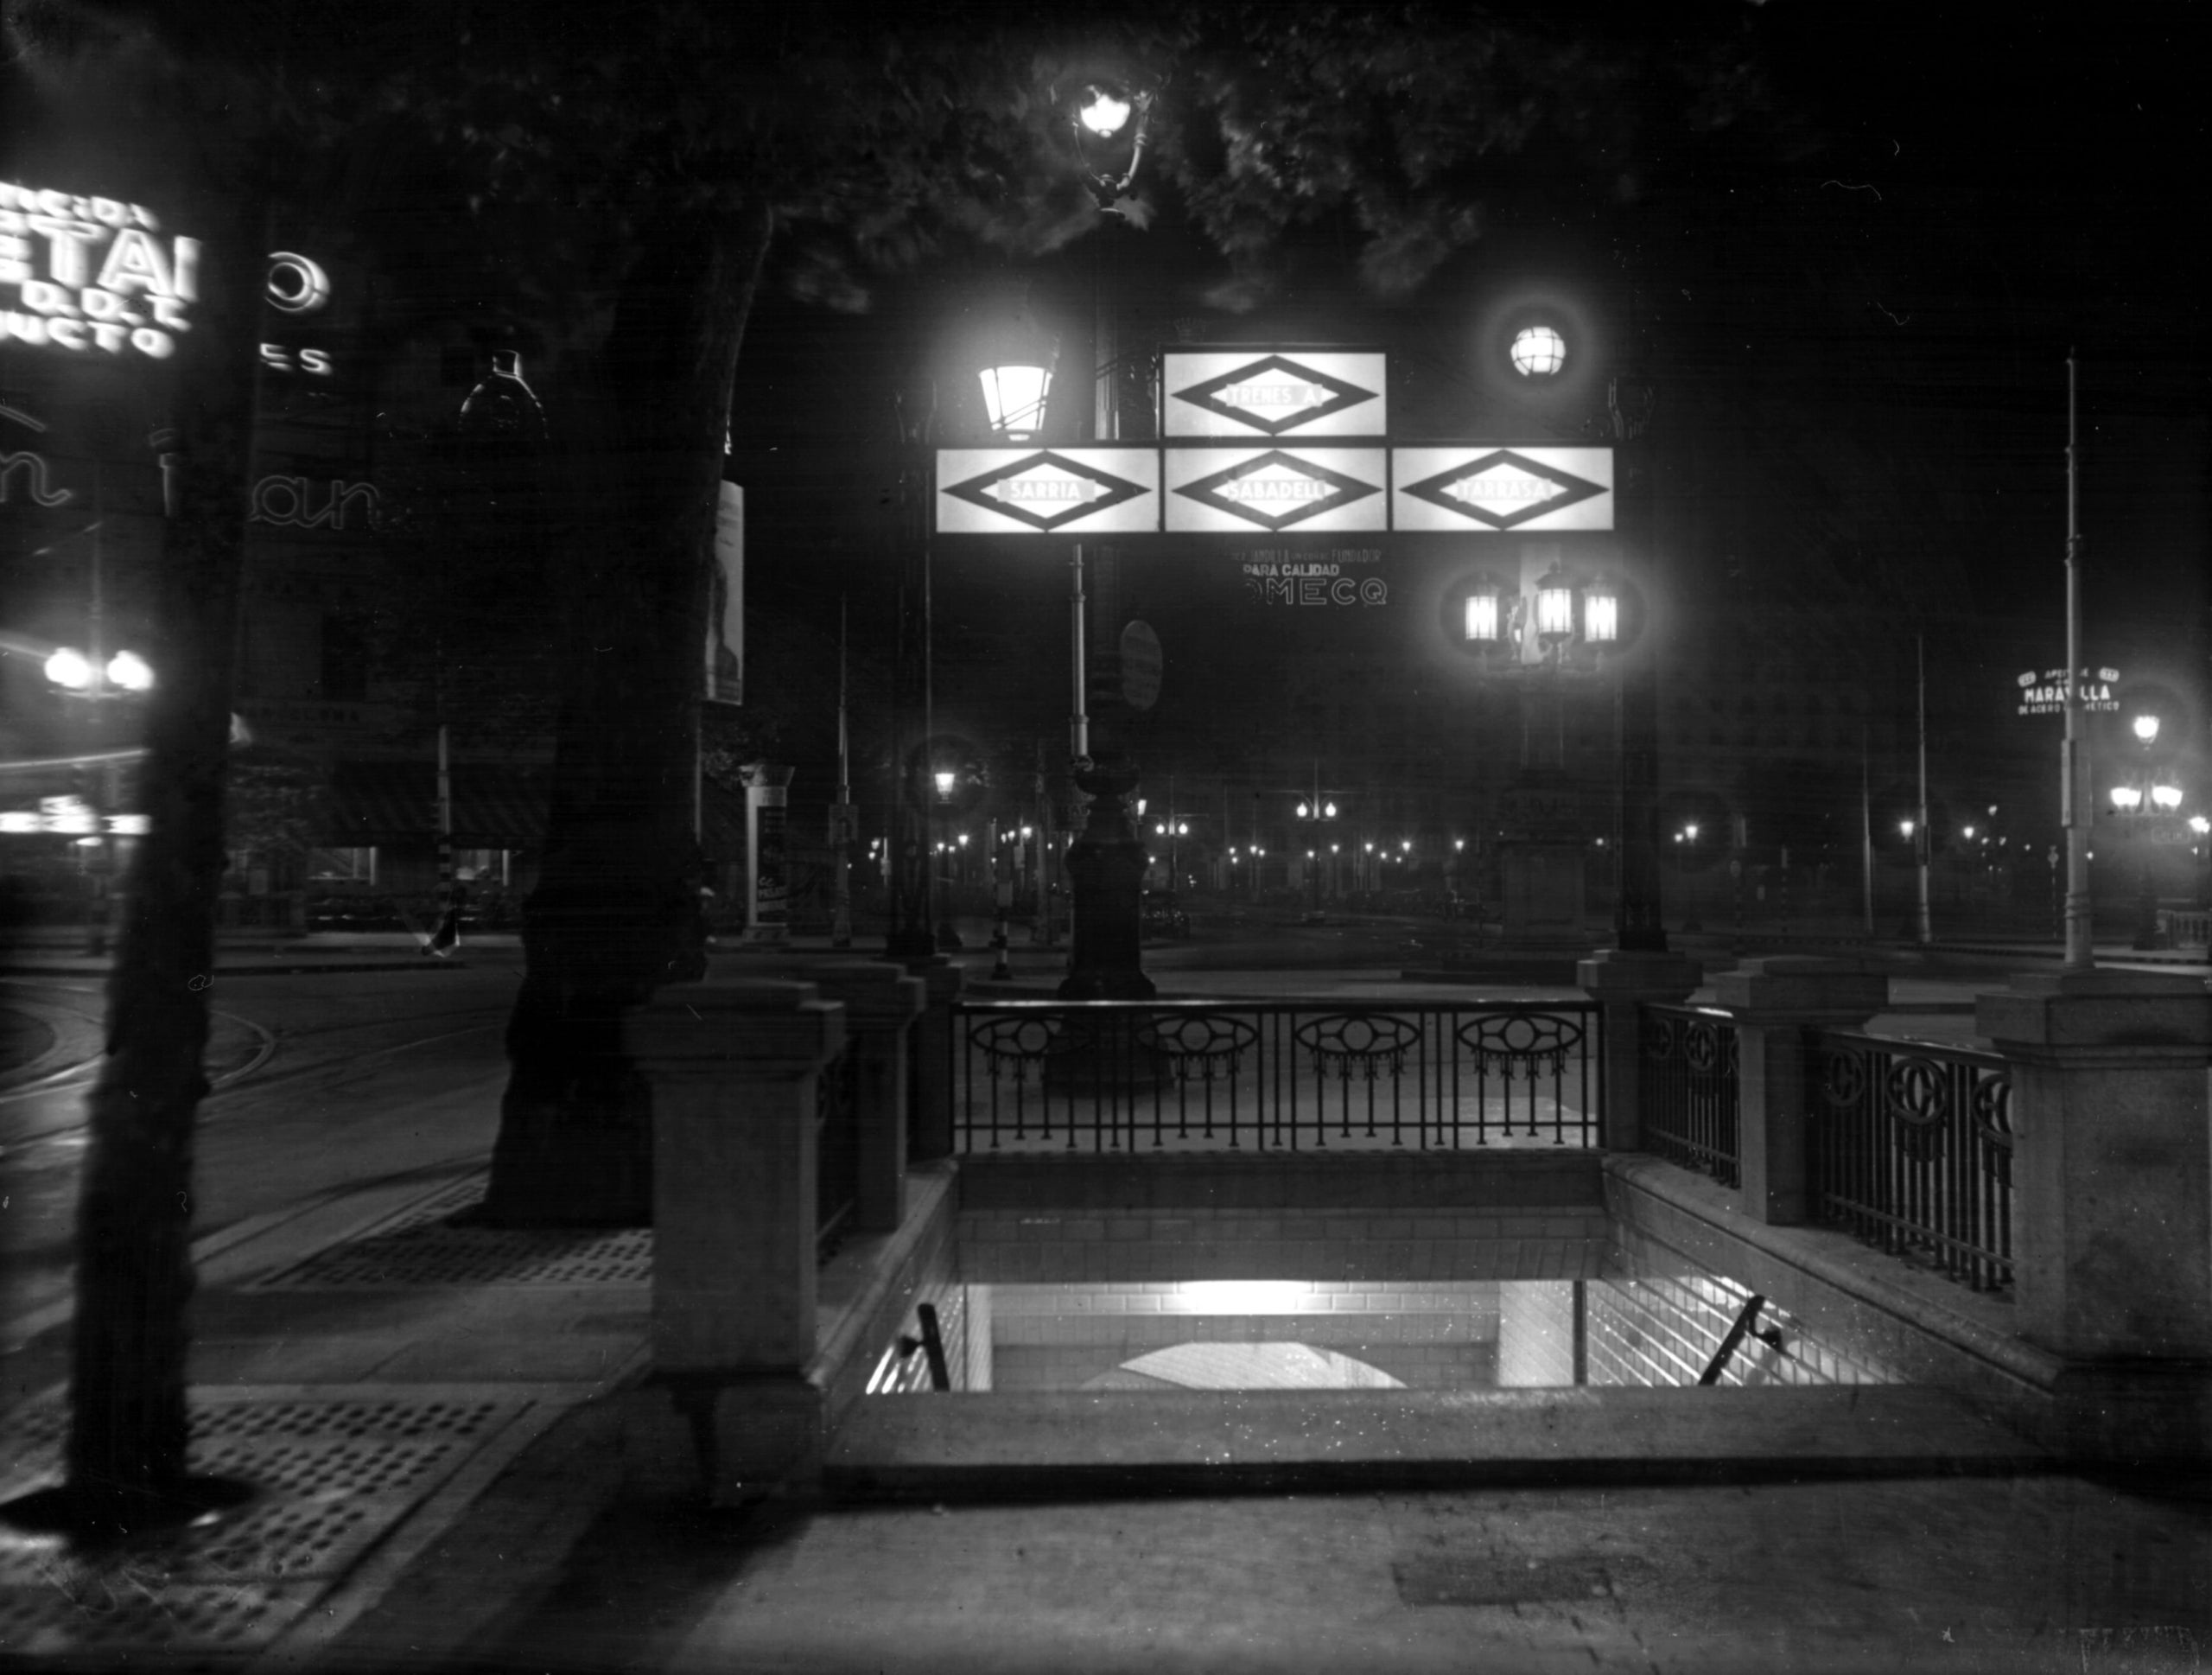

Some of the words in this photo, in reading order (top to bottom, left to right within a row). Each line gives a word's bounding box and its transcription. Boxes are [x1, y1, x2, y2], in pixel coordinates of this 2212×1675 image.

[0, 309, 173, 359] UCTO
[1229, 386, 1293, 404] TRENES
[1302, 386, 1318, 404] A
[1010, 481, 1082, 500] SARRIA
[1228, 481, 1323, 500] SABADELL
[1460, 481, 1547, 500] TARRASA
[1281, 564, 1340, 577] CALIDAD
[2024, 684, 2111, 703] MARAVLLA
